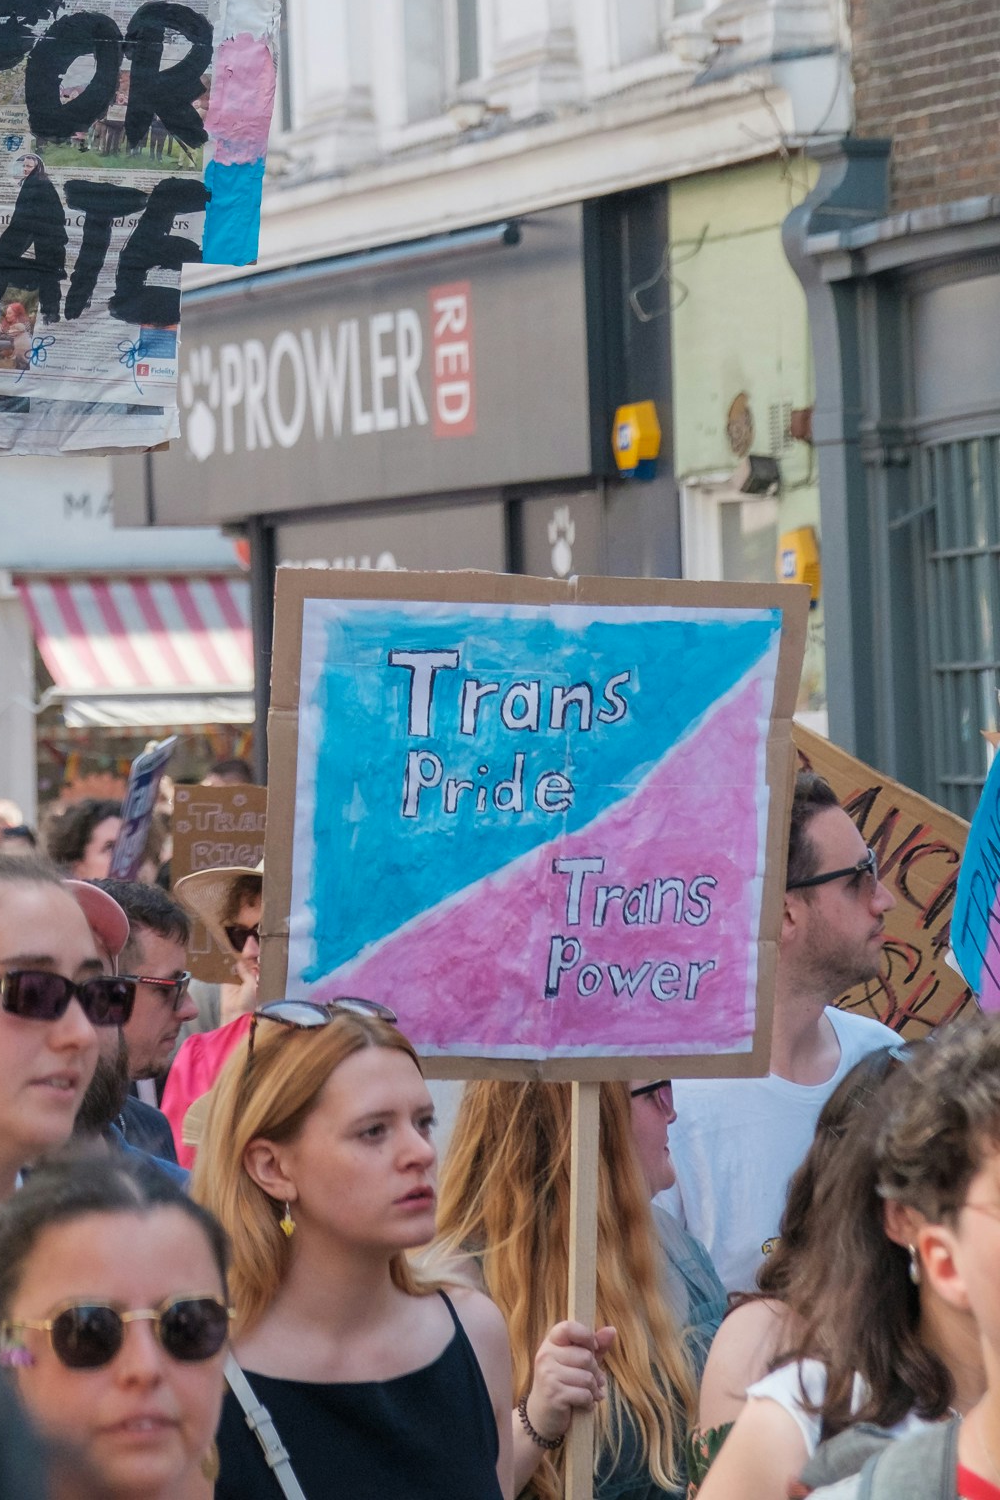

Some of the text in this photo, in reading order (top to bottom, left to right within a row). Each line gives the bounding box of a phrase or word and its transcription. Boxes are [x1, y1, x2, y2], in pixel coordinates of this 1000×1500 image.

[151, 366, 176, 376] Fidelity
[220, 308, 429, 455] PROWLER
[434, 295, 470, 425] RED
[388, 649, 630, 738] Trans
[402, 750, 575, 818] Pride
[552, 857, 717, 927] Trans
[544, 935, 716, 1001] Power
